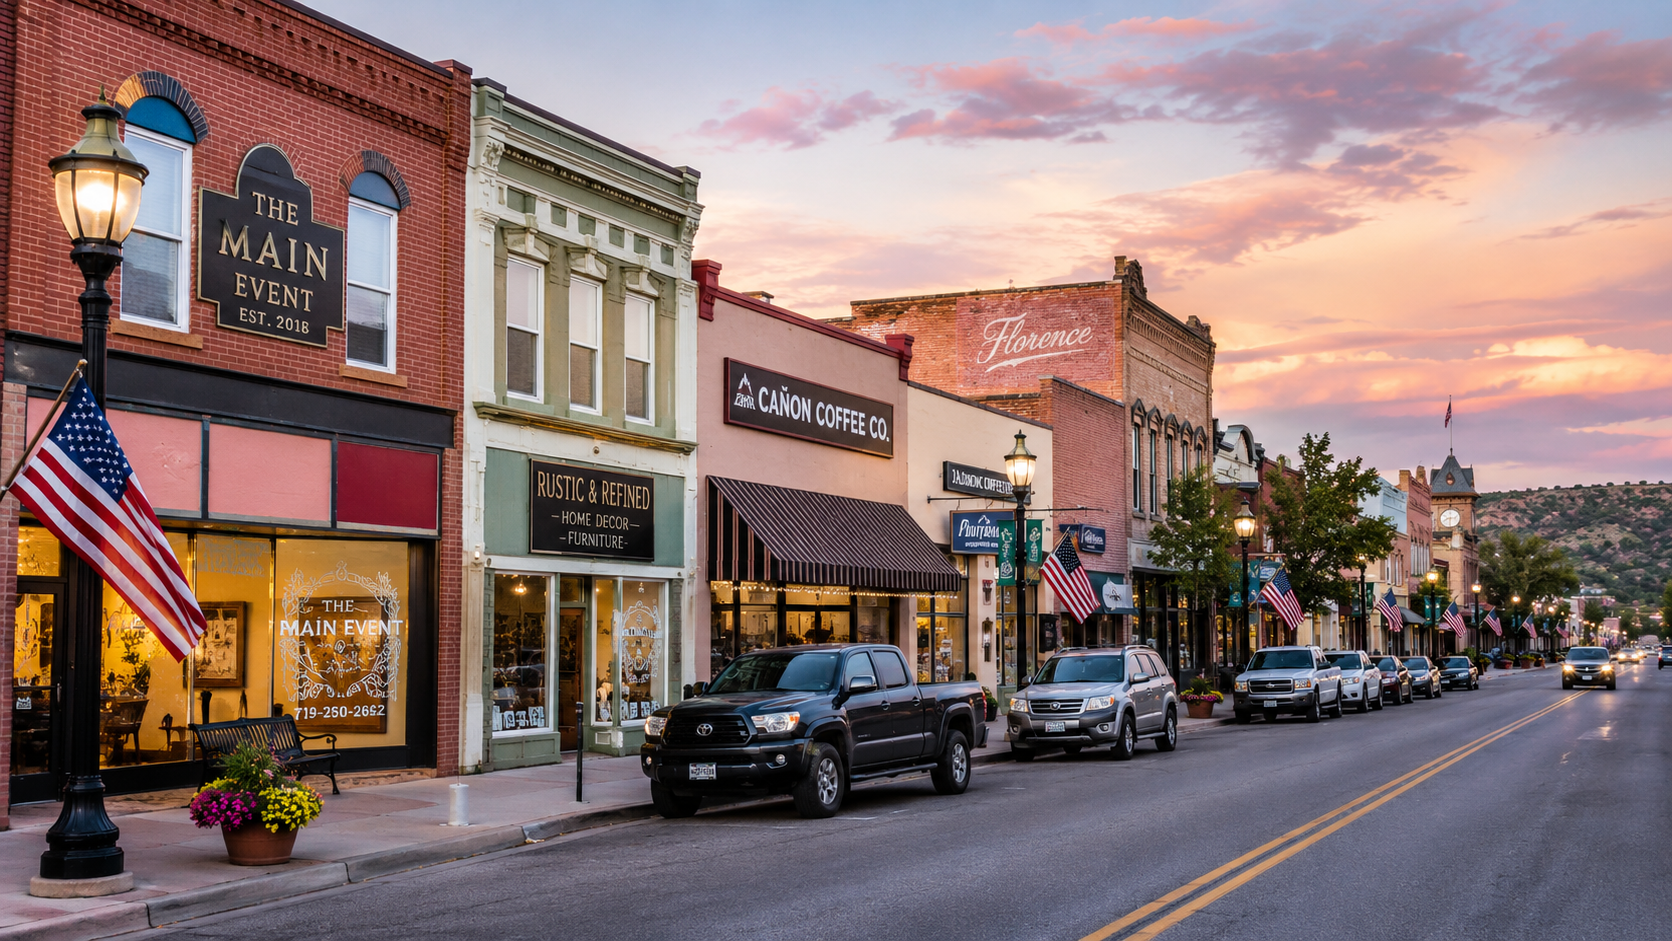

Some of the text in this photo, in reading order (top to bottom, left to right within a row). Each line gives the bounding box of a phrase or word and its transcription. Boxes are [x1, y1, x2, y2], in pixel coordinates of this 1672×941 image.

[252, 191, 299, 226] THE
[218, 219, 329, 281] MAIN
[234, 272, 314, 313] EVENT
[239, 306, 310, 334] EST. 2018
[976, 312, 1093, 364] Florence
[816, 401, 866, 436] COFFEE
[869, 415, 890, 442] CO.
[537, 470, 651, 510] RUSTIC & REFINED
[561, 510, 629, 531] HOME DECOR
[321, 600, 354, 613] THE
[344, 619, 404, 636] EVENT
